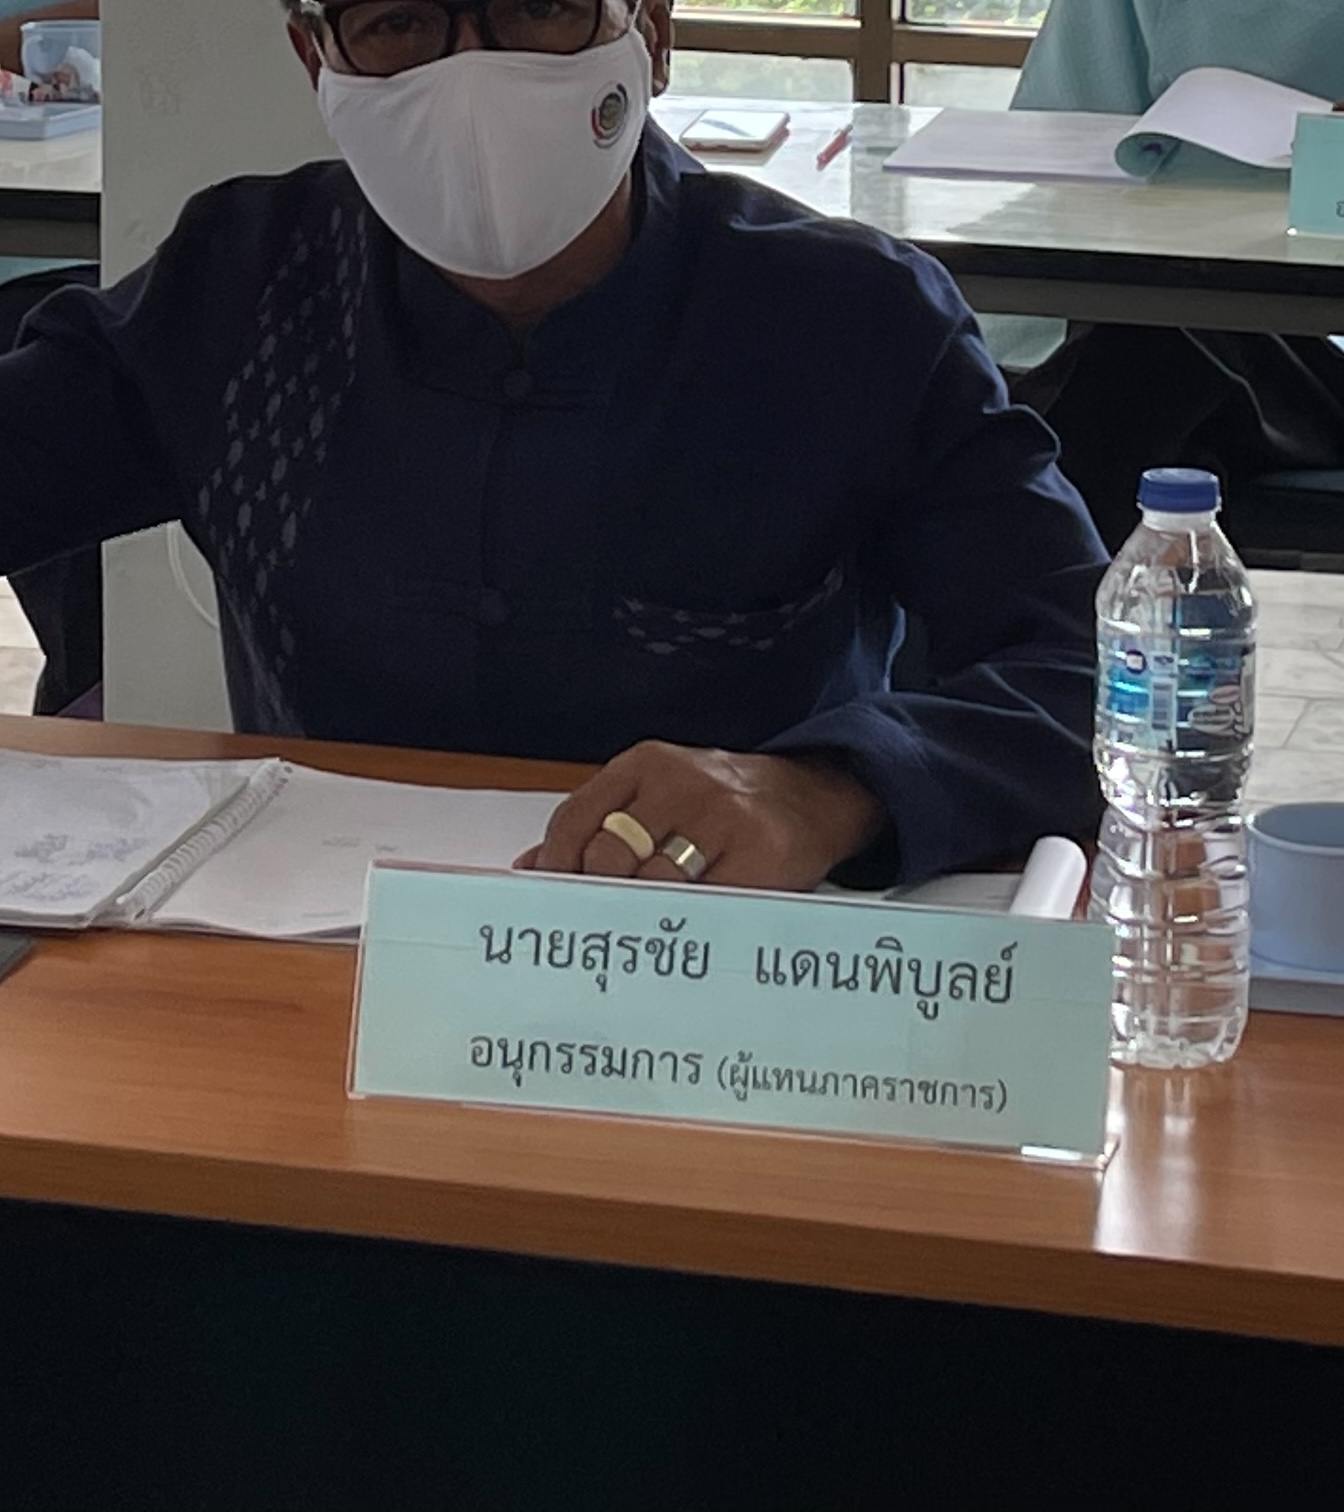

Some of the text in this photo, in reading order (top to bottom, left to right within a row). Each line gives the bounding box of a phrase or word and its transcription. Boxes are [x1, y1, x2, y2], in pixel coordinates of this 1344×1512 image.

[478, 917, 1018, 1021] นายสุรชัย แดนพิบูลย์
[469, 1035, 1010, 1114] อนุกรรมการ (ผู้แทนภาคราชการ)
